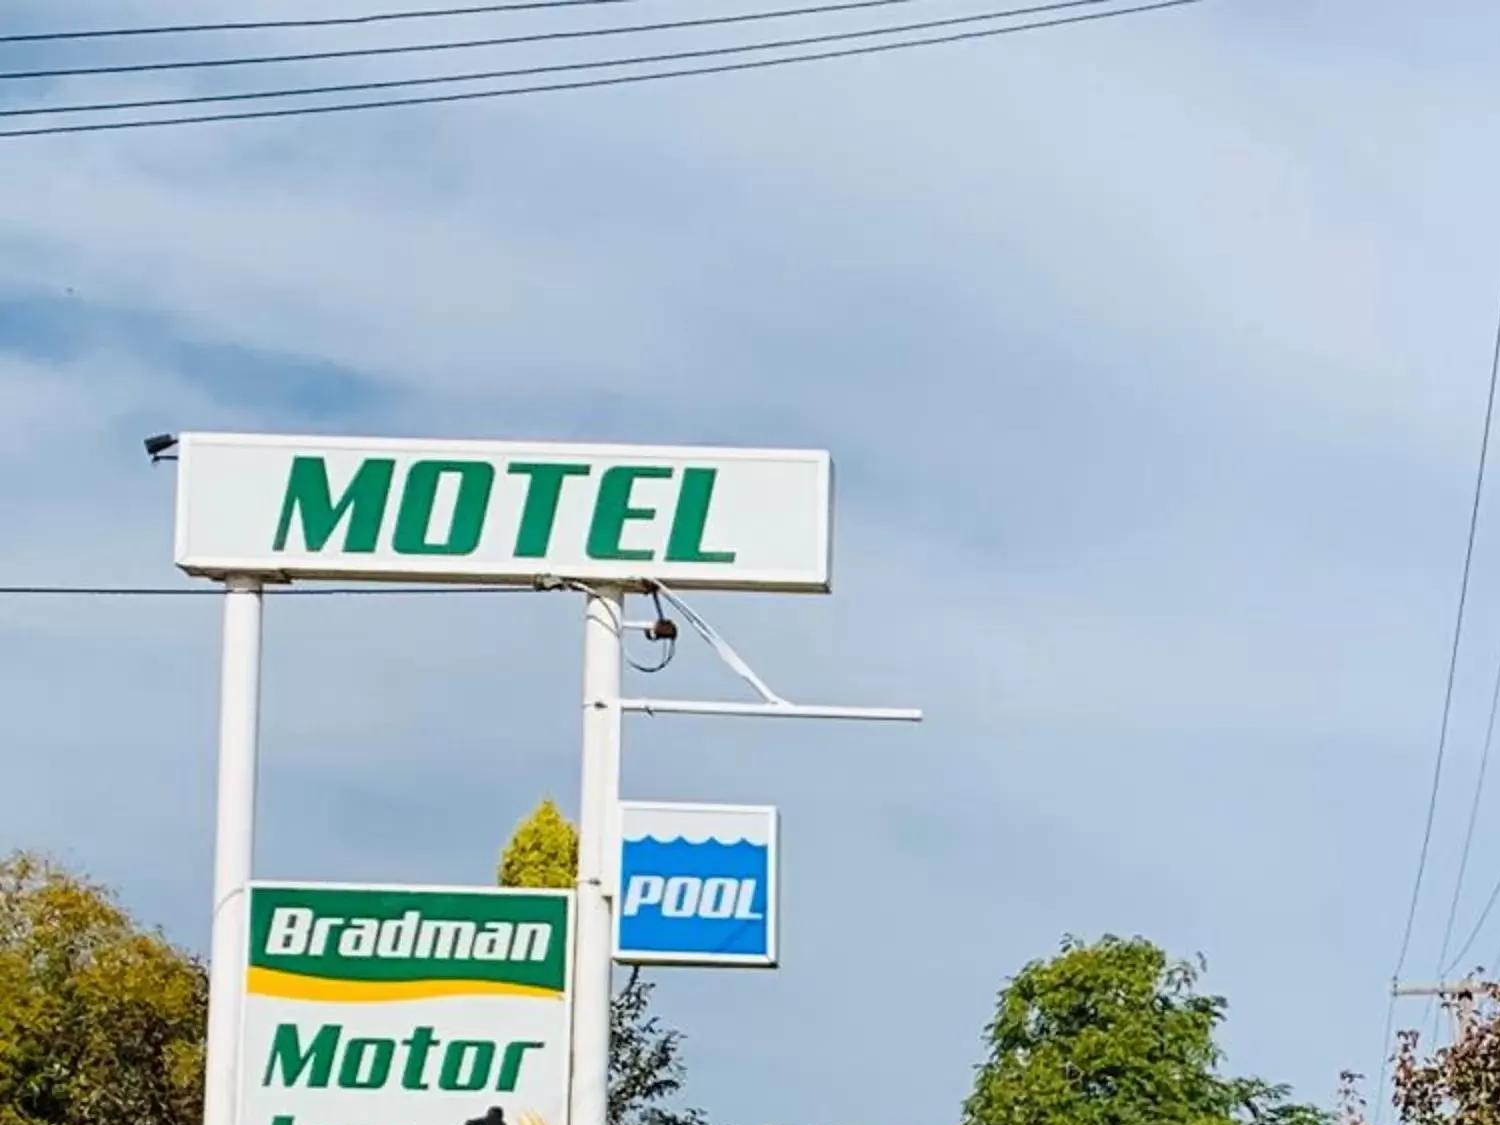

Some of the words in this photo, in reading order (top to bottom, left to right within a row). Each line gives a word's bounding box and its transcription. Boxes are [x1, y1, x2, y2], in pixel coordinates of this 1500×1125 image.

[273, 454, 737, 564] MOTEL
[624, 873, 763, 922] POOL
[265, 907, 552, 961] Bradman
[262, 1023, 544, 1092] Motor
